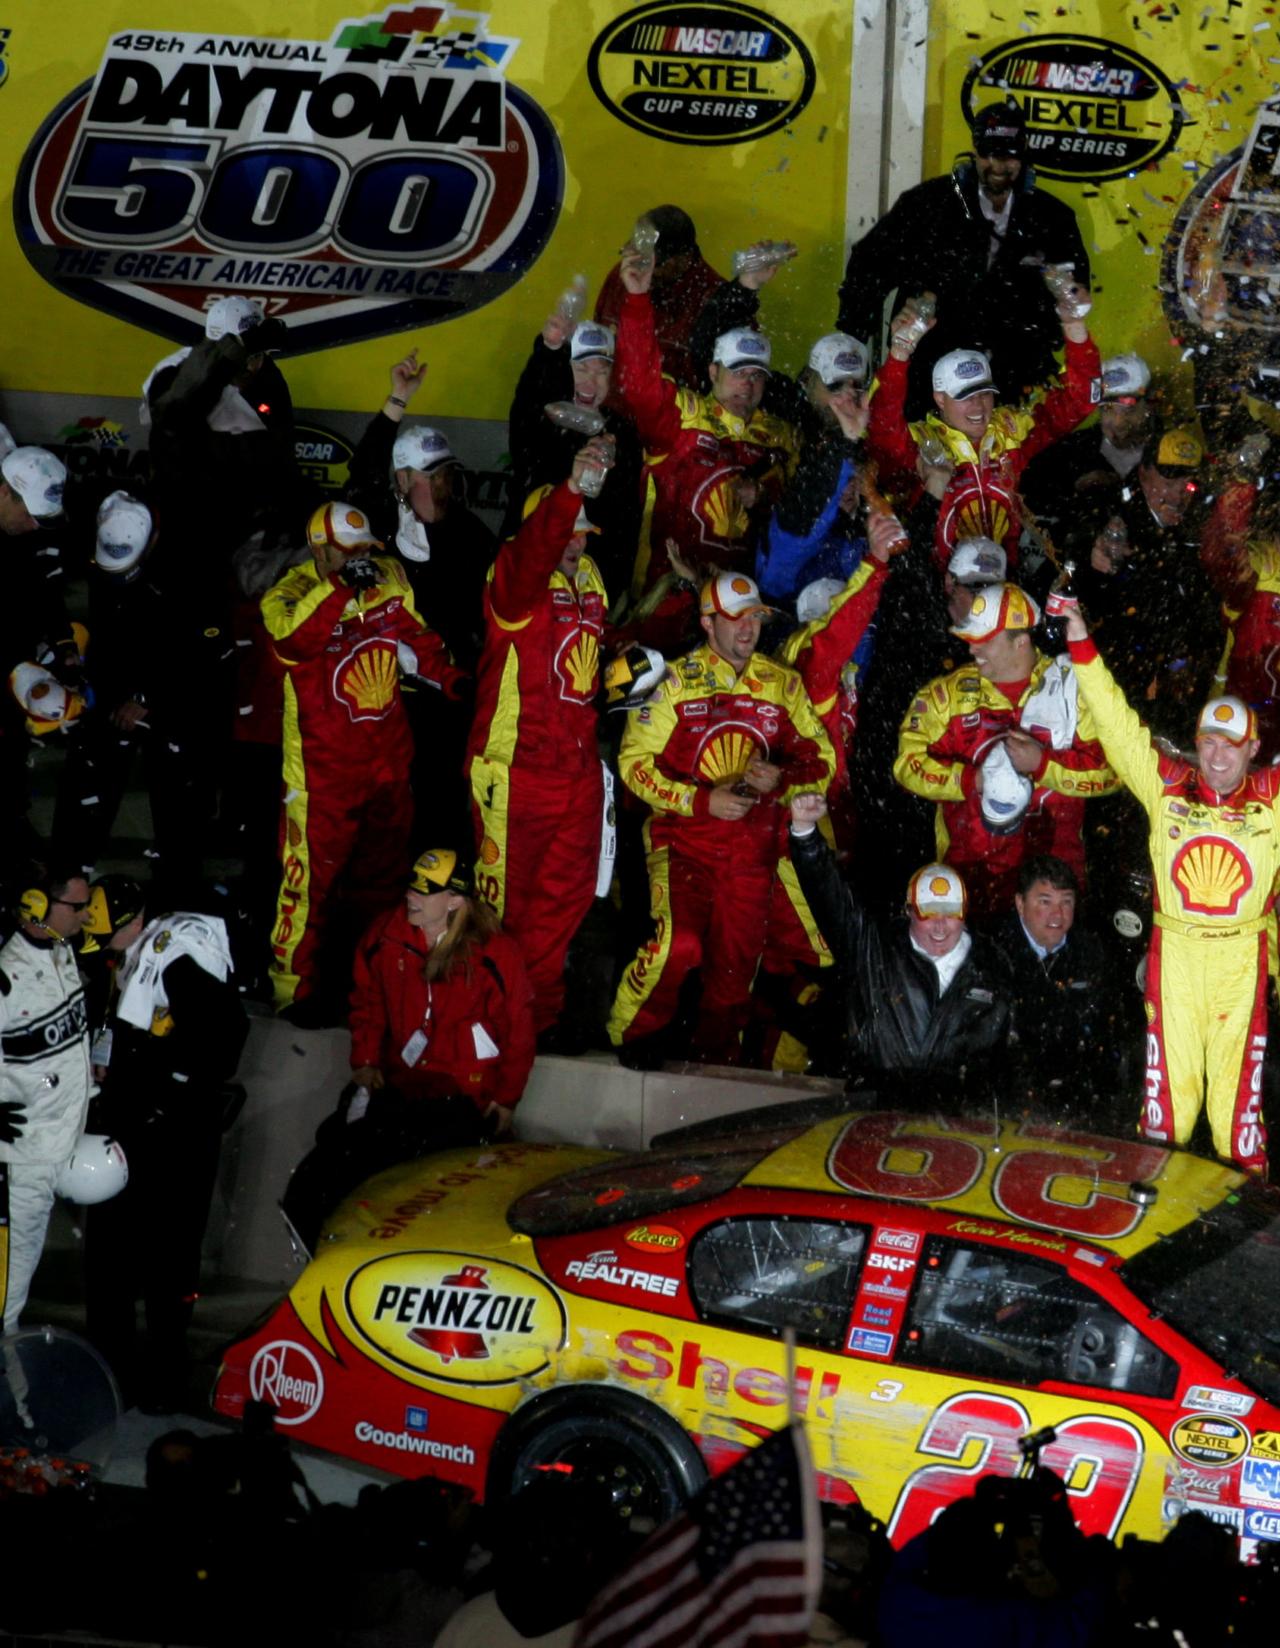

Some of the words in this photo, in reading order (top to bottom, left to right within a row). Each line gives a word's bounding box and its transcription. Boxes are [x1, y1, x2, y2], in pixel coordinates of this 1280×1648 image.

[112, 34, 184, 54] 49th
[200, 39, 327, 63] ANNUAL
[675, 27, 765, 57] NASCAR
[633, 59, 769, 94] NEXTEL
[1045, 62, 1135, 96] NASCAR
[87, 58, 503, 146] DAYTONA
[644, 98, 683, 114] CUP
[689, 101, 758, 119] SERIES
[1026, 134, 1055, 150] UP
[1059, 138, 1127, 157] SERIES
[52, 130, 496, 267] 500
[53, 248, 108, 275] THE
[114, 253, 207, 281] GREAT
[213, 261, 373, 291] AMERICAN
[376, 273, 457, 296] RACE
[295, 442, 332, 461] SCAR
[634, 768, 681, 804] Shell
[909, 759, 949, 785] Shell
[1146, 1033, 1168, 1141] Shel
[1238, 1036, 1267, 1157] Shell
[587, 1250, 618, 1263] Team
[867, 1253, 916, 1272] SKF
[565, 1261, 680, 1297] REALTREE
[373, 1284, 537, 1334] PENNZOIL
[865, 1304, 892, 1316] Road
[259, 1346, 317, 1407] Rheem
[870, 1379, 904, 1402] 3
[355, 1421, 476, 1465] Goodwrench
[1187, 1433, 1231, 1449] NEXTEL
[1164, 1498, 1239, 1527] Comit
